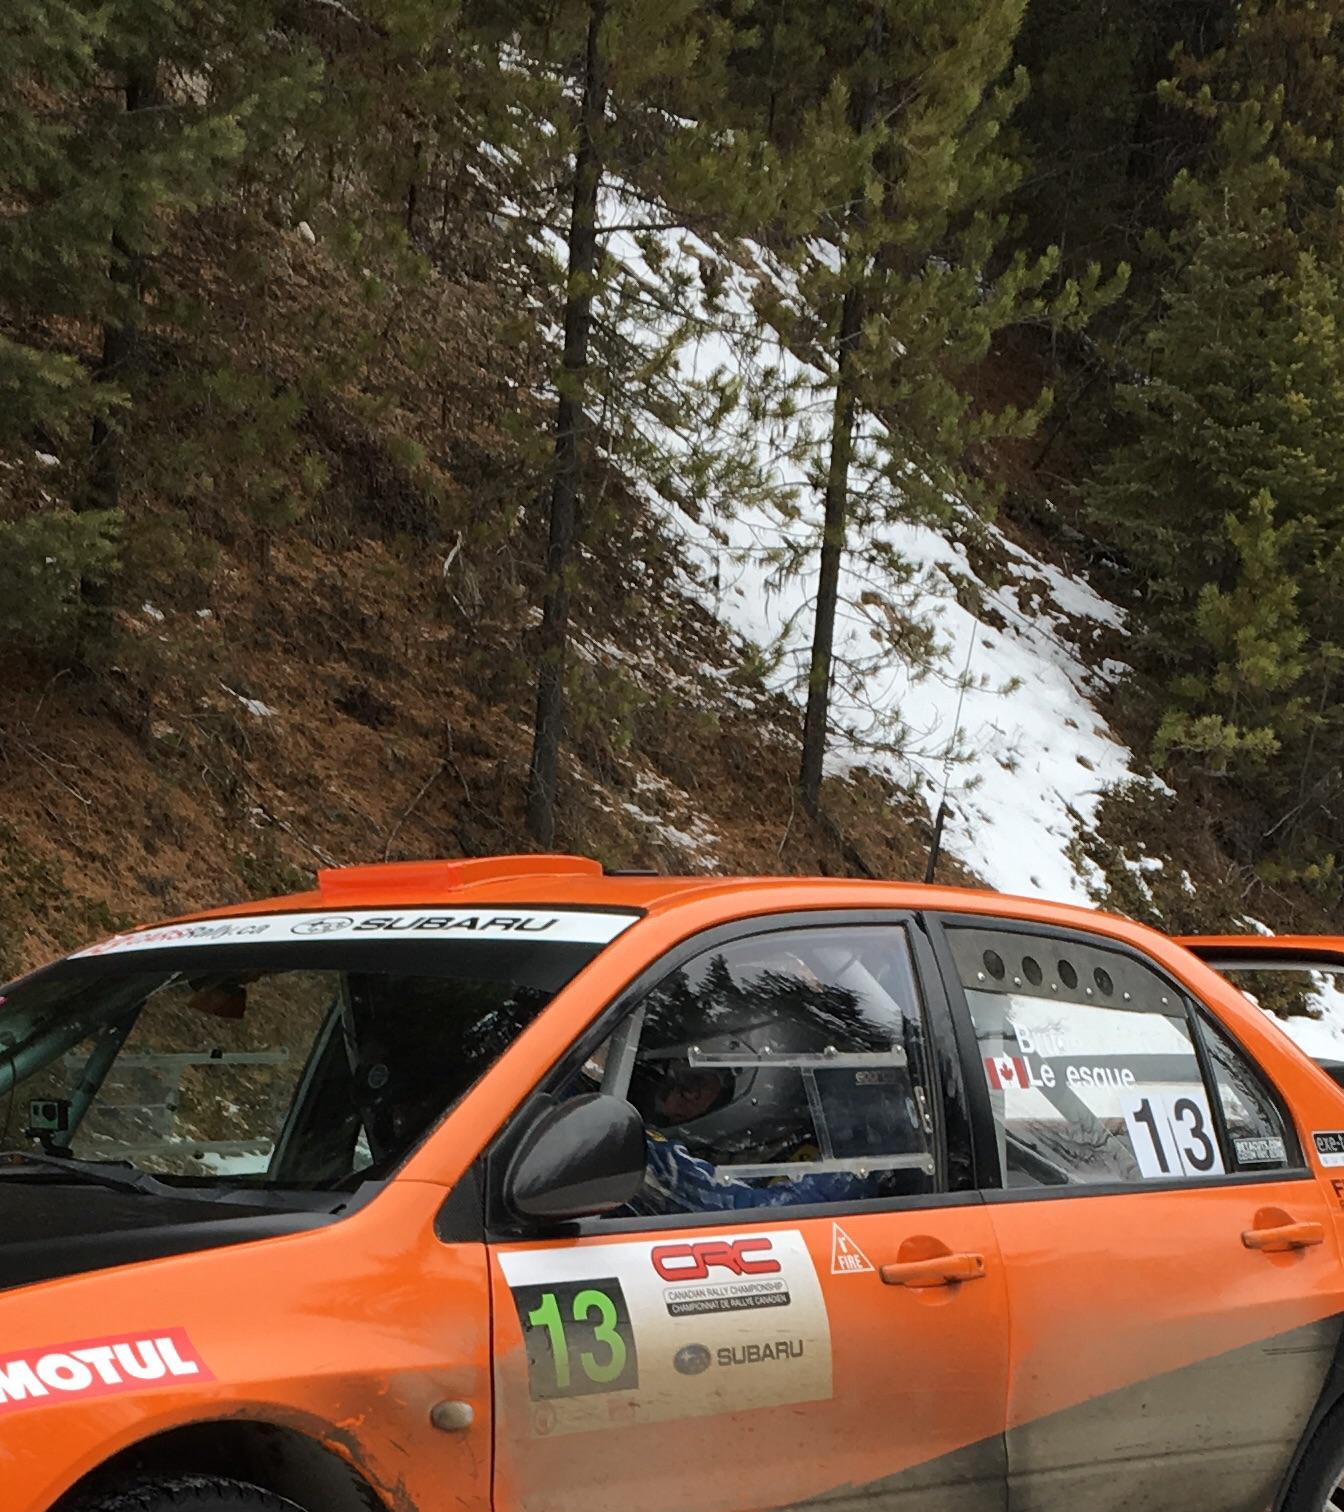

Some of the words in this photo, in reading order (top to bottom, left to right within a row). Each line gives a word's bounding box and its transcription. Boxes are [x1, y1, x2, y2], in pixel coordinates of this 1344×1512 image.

[353, 917, 560, 932] SUBARU
[1133, 1098, 1214, 1173] 13
[651, 1237, 781, 1282] CRC
[838, 1254, 863, 1270] FIRE
[668, 1288, 706, 1301] CANADIAN
[706, 1286, 729, 1297] RALLY
[730, 1281, 783, 1295] CHAMPIONSHIP
[672, 1299, 720, 1314] CHAMPIONNAT
[730, 1296, 755, 1308] RALLYE
[755, 1293, 787, 1305] CANADIEN
[528, 1289, 626, 1388] 13
[717, 1339, 804, 1366] SUBARU
